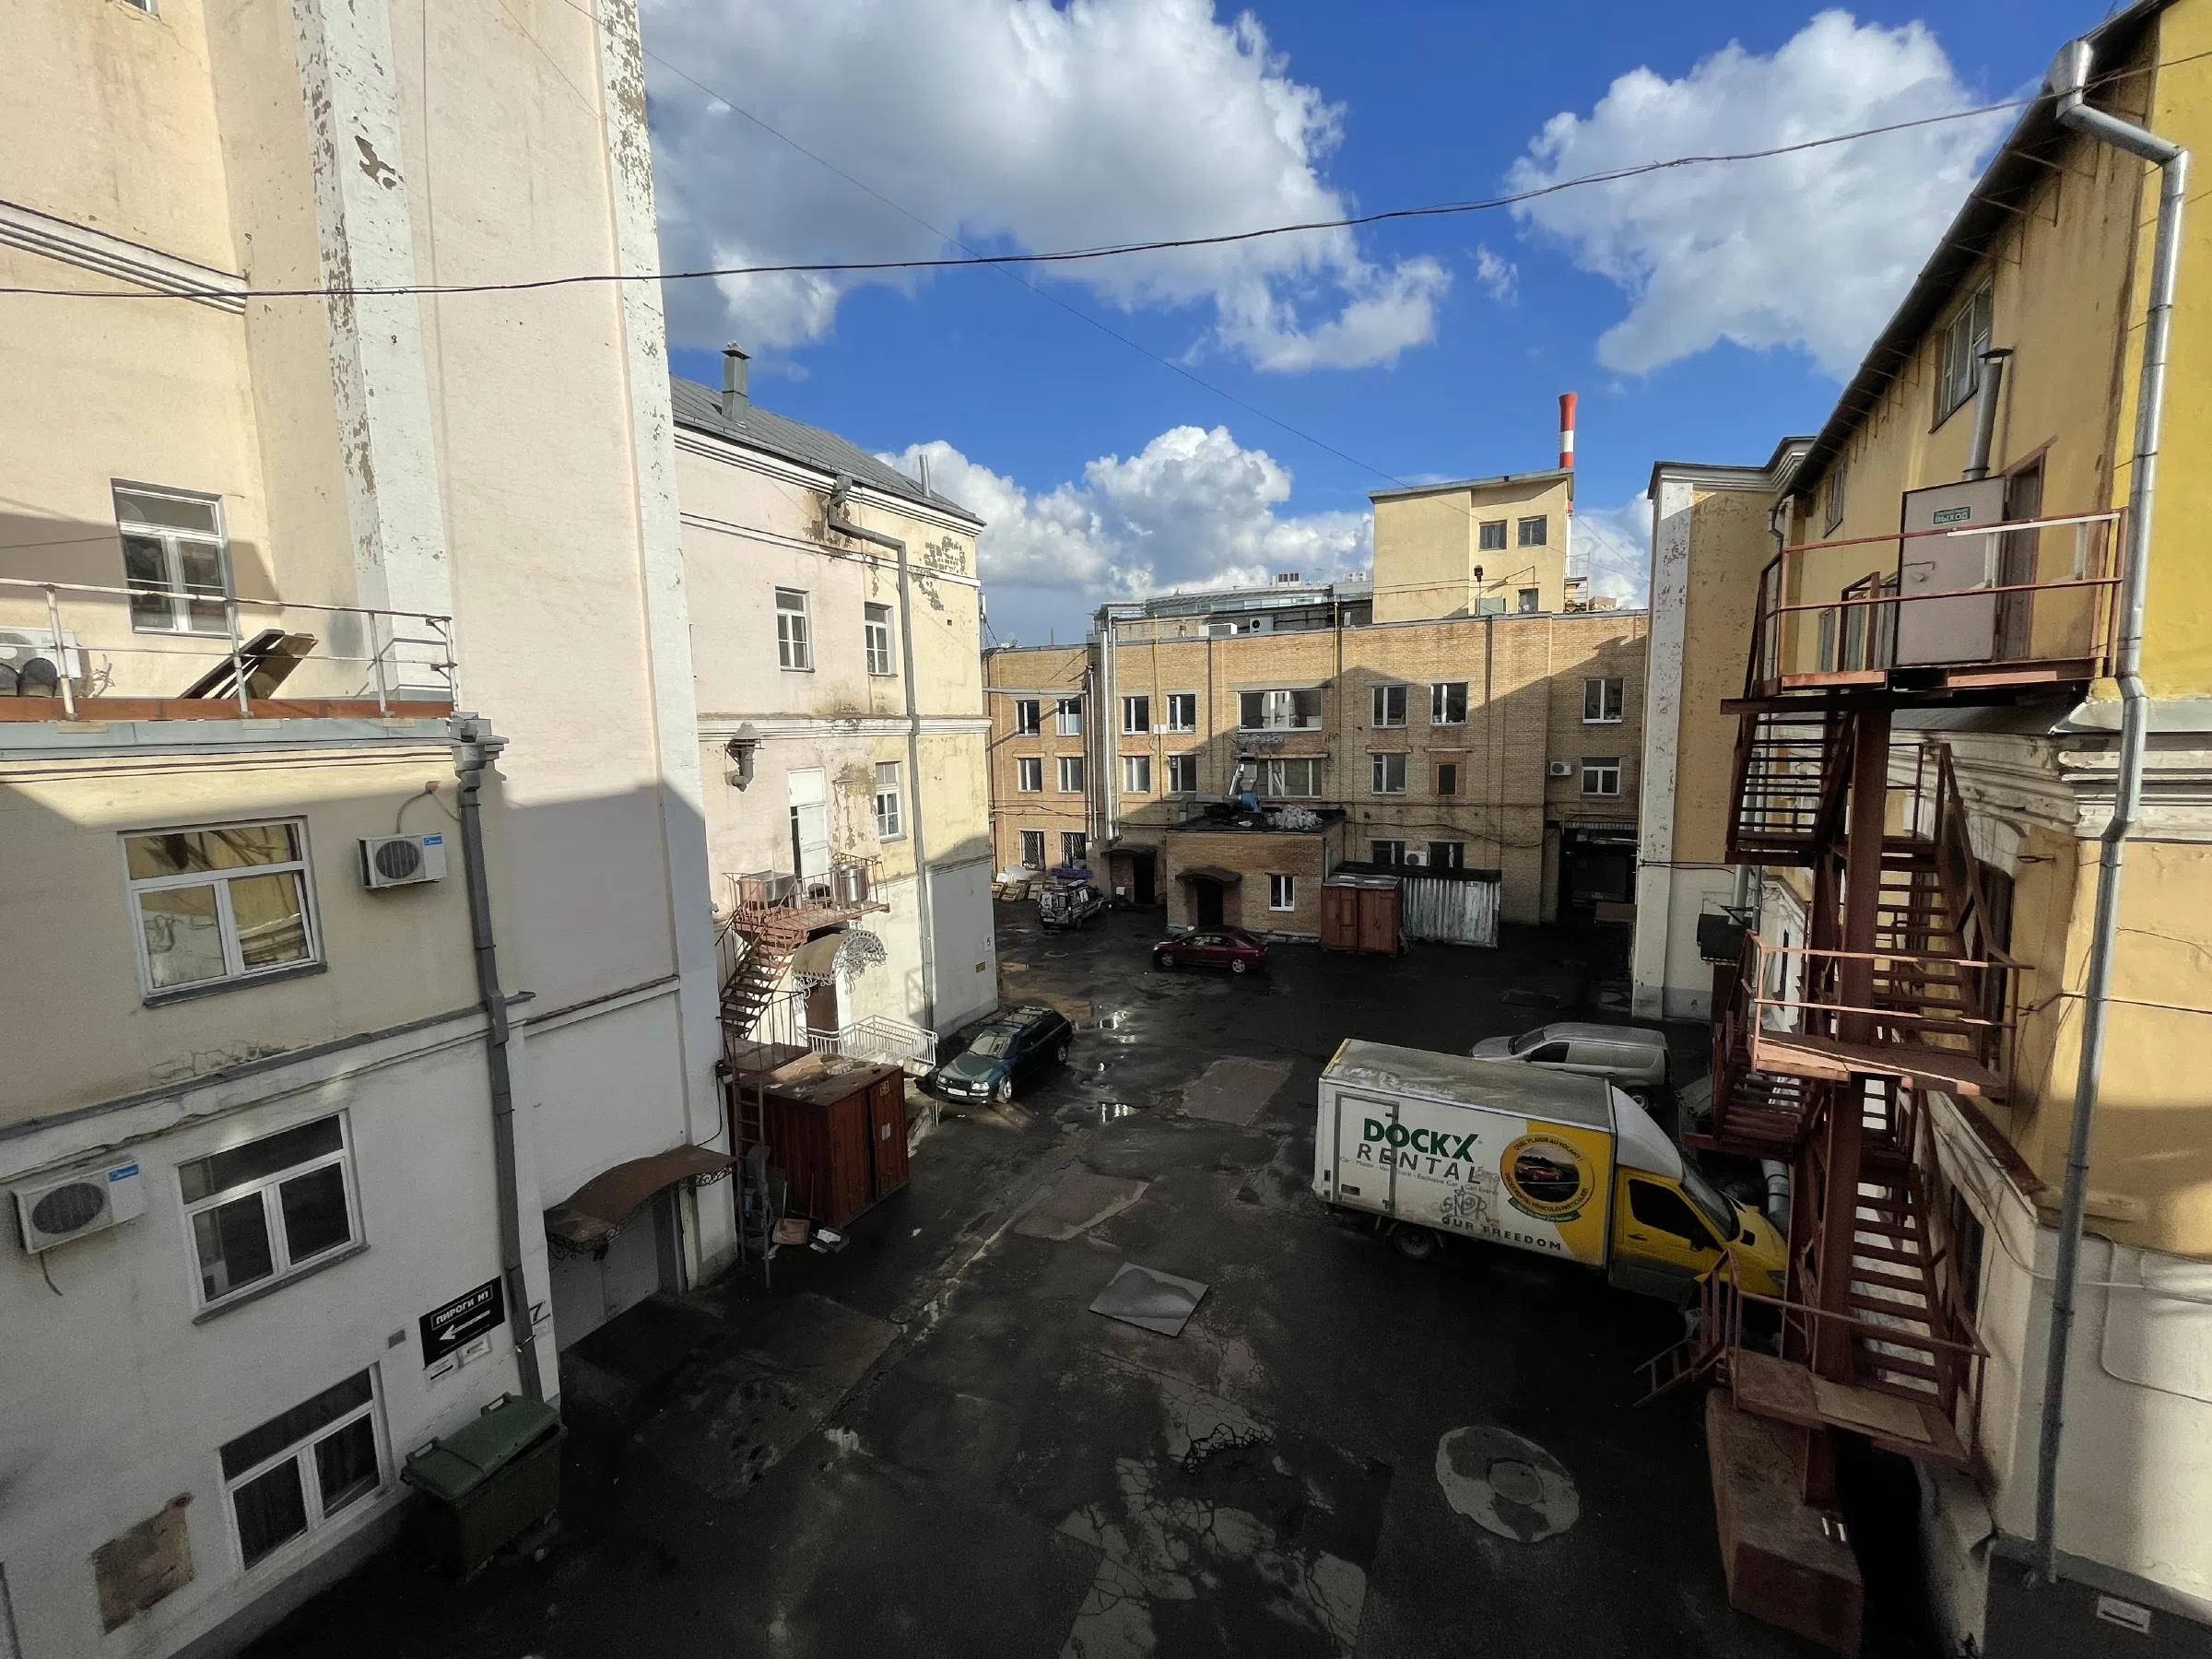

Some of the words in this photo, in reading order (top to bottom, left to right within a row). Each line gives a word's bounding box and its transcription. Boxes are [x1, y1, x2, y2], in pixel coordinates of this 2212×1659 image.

[1935, 512, 1969, 524] ВЫХОД
[1363, 1117, 1479, 1163] DOCKX
[1339, 1156, 1351, 1164] Car
[1356, 1159, 1374, 1169] Motor
[1357, 1142, 1481, 1185] RENTAL
[1482, 1225, 1561, 1251] FREEDOM
[436, 1298, 475, 1324] ПИРОГИ
